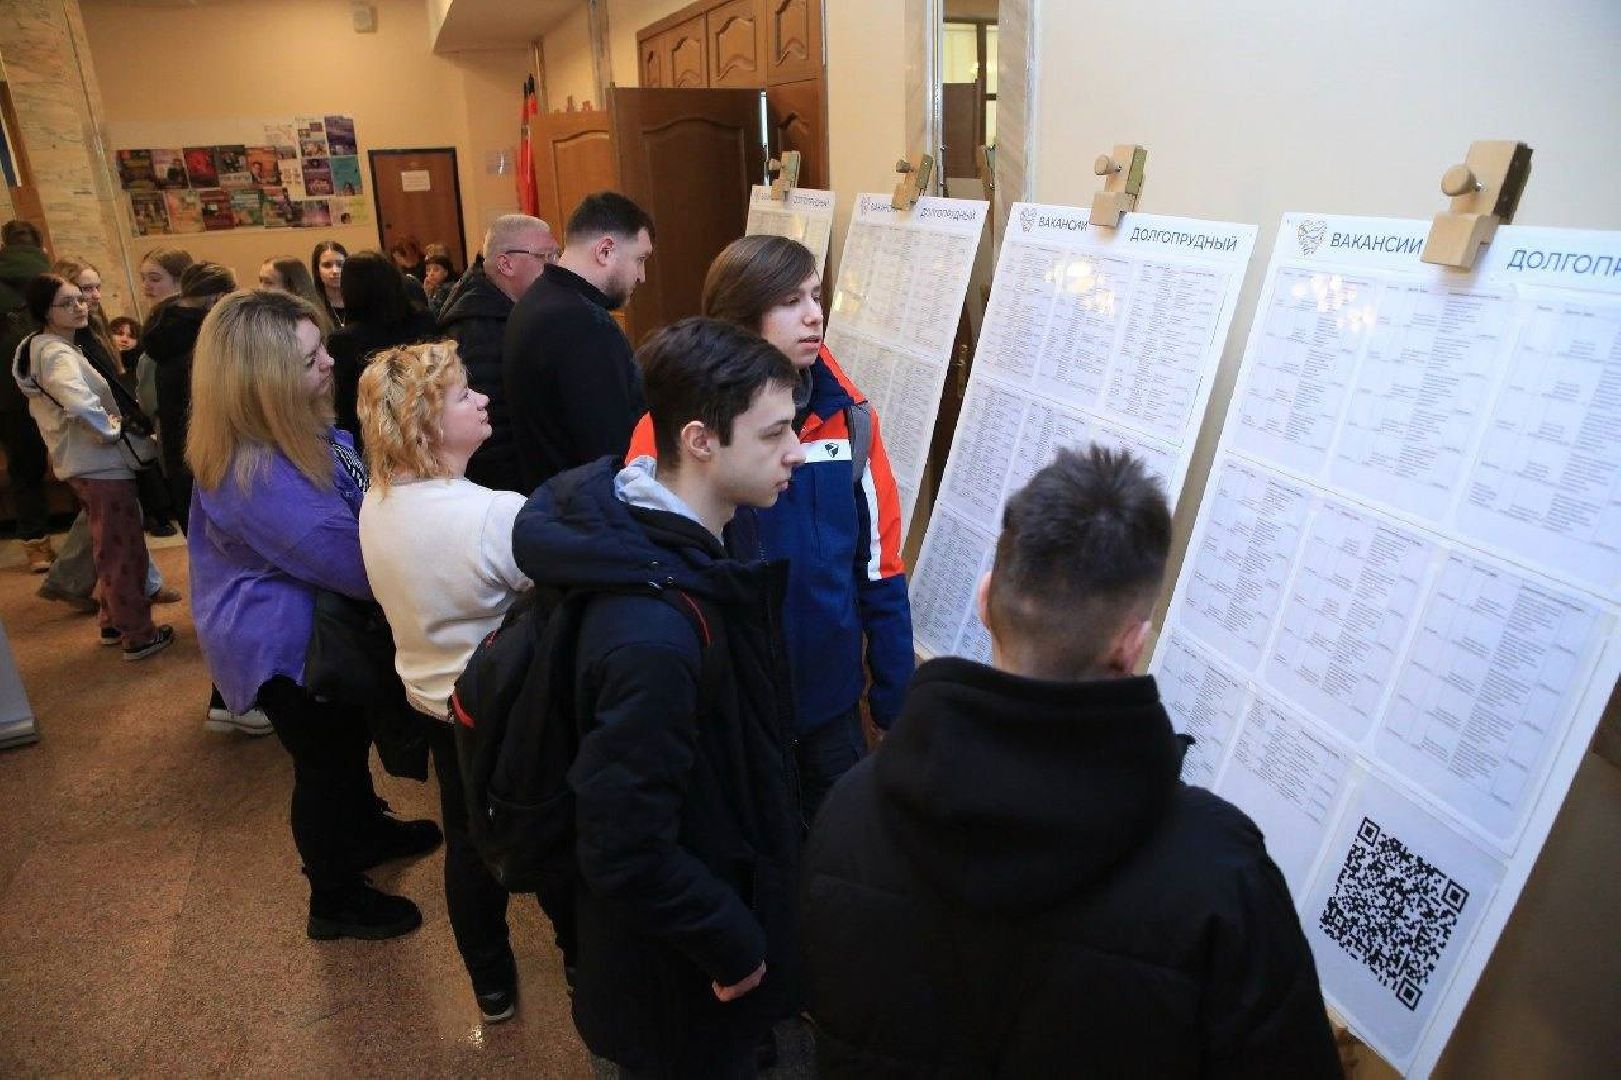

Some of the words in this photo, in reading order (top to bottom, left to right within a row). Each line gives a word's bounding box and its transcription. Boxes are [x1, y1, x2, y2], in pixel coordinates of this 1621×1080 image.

[1038, 215, 1089, 232] ВАКАНСИИ
[1129, 226, 1239, 252] ДОЛГОПРУДНЫЙ
[1329, 231, 1424, 255] ВАКАНСИИ
